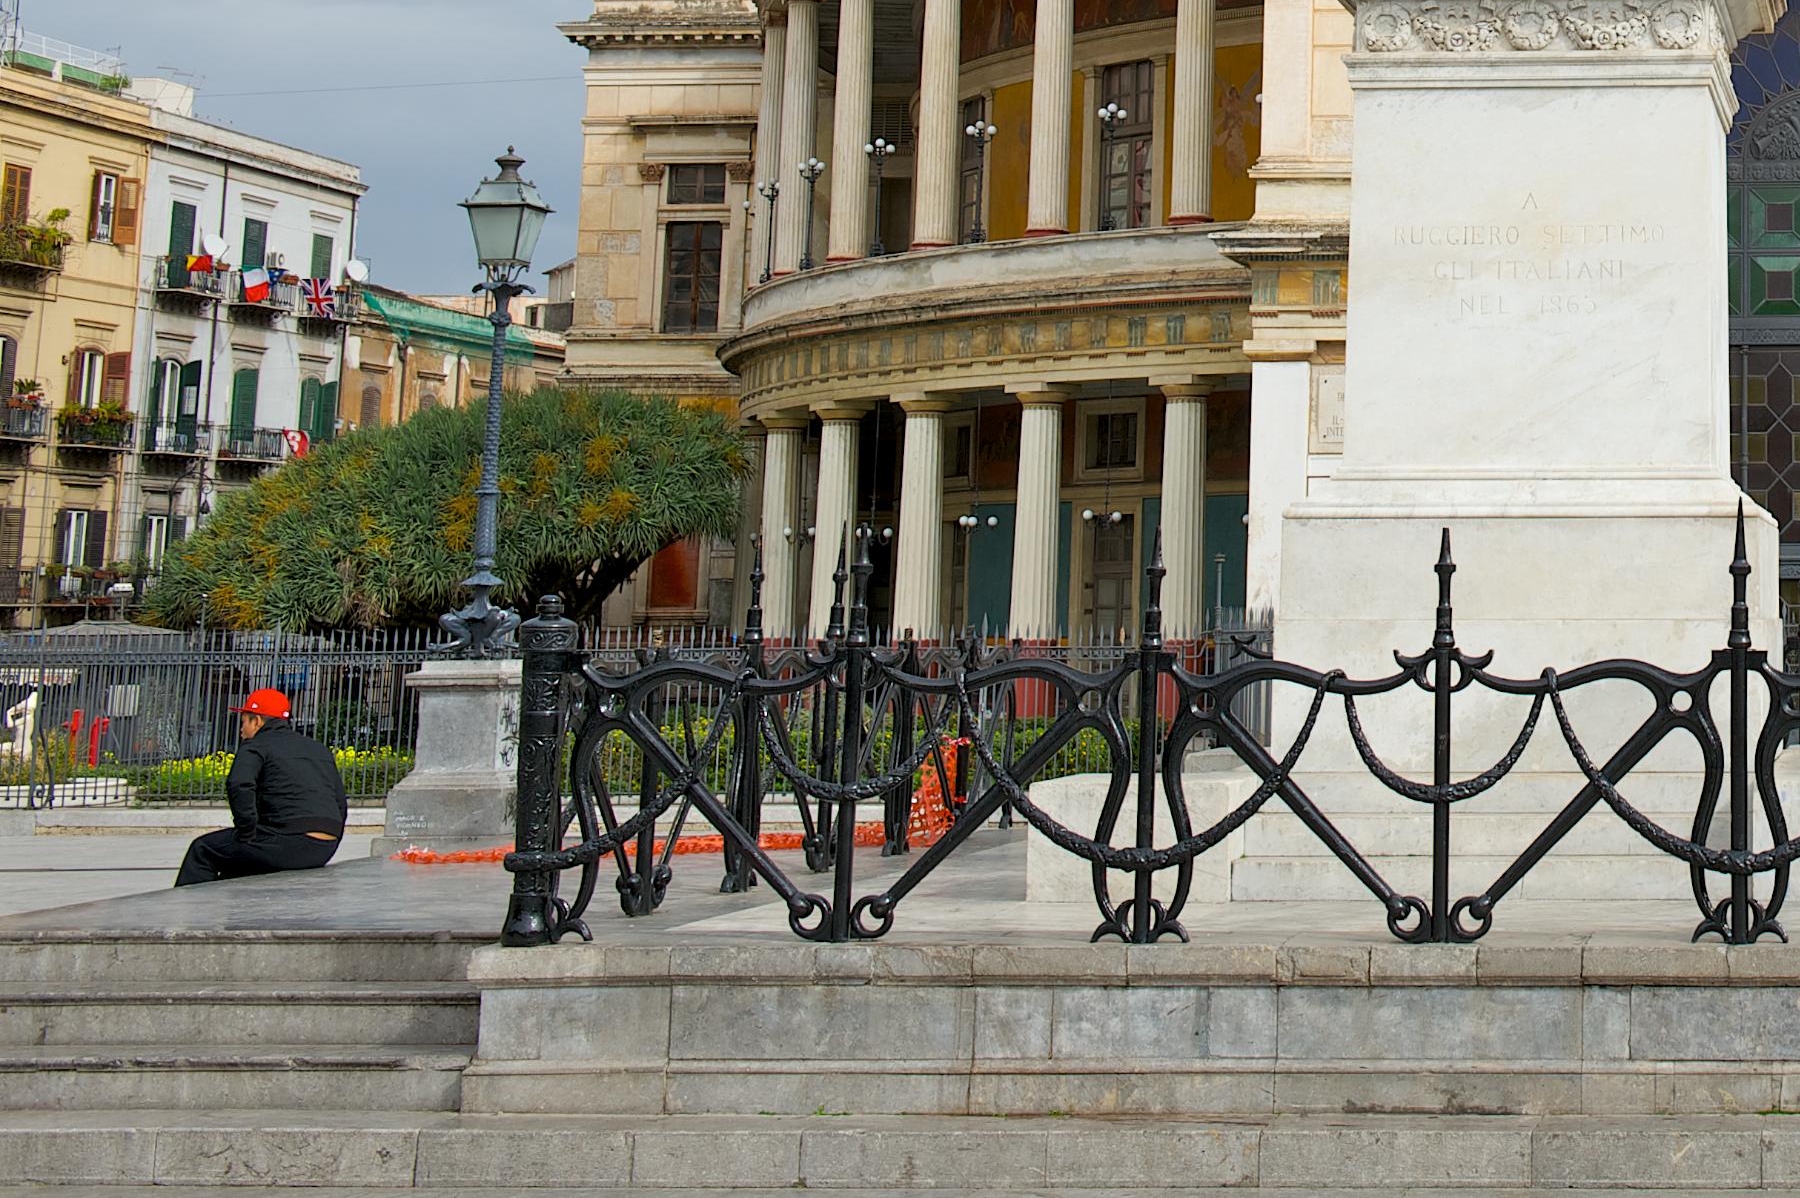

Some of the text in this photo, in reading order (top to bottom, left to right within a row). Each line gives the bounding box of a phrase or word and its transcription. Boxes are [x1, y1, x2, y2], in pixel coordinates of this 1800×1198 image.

[1521, 191, 1539, 210] A
[1393, 224, 1666, 246] RUGGIERO SETTIMO
[1433, 258, 1625, 281] GLI ITALIANI
[1459, 294, 1513, 316] NEL
